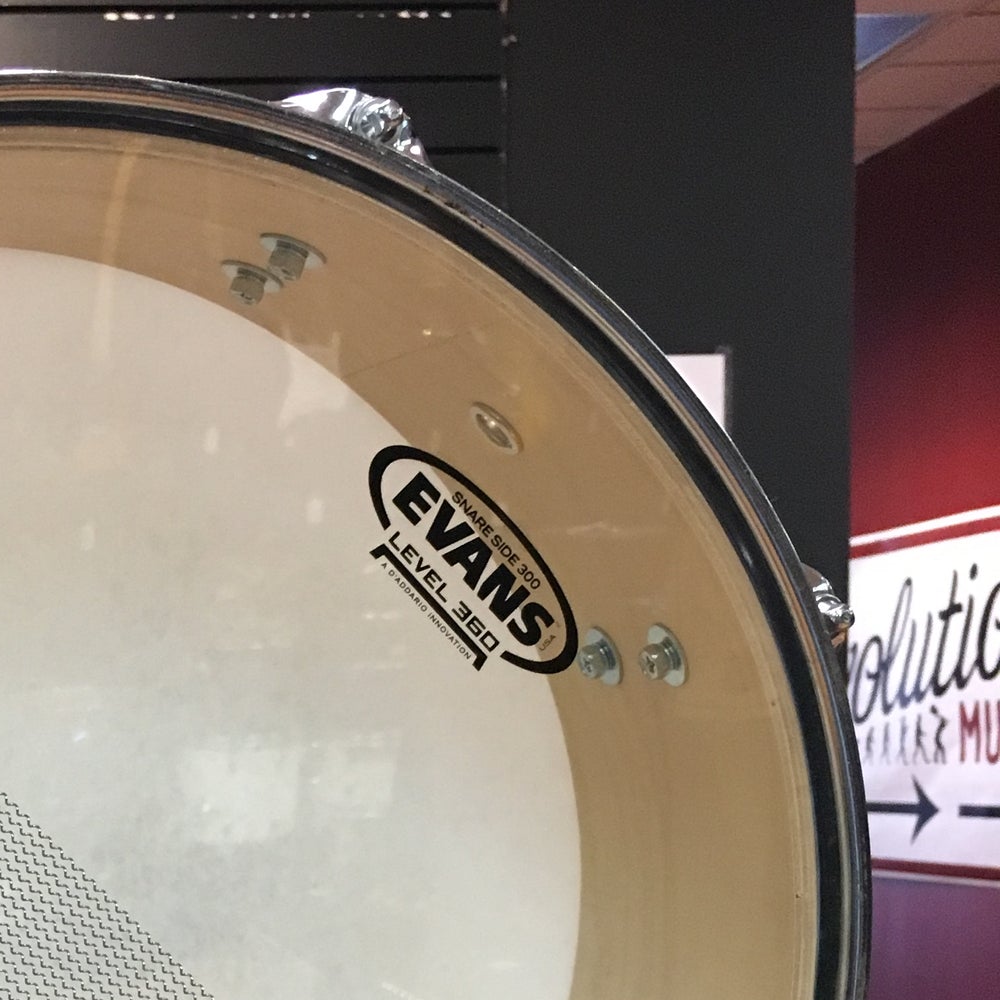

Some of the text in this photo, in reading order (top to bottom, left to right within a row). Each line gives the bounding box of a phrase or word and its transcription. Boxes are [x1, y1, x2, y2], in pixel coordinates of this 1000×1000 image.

[392, 471, 555, 646] EVANS
[452, 491, 541, 590] SNARE SIDE 300
[380, 562, 473, 660] A D'ADDARIO INNOVATION
[388, 531, 500, 652] LEVEL 360
[538, 634, 556, 652] USA
